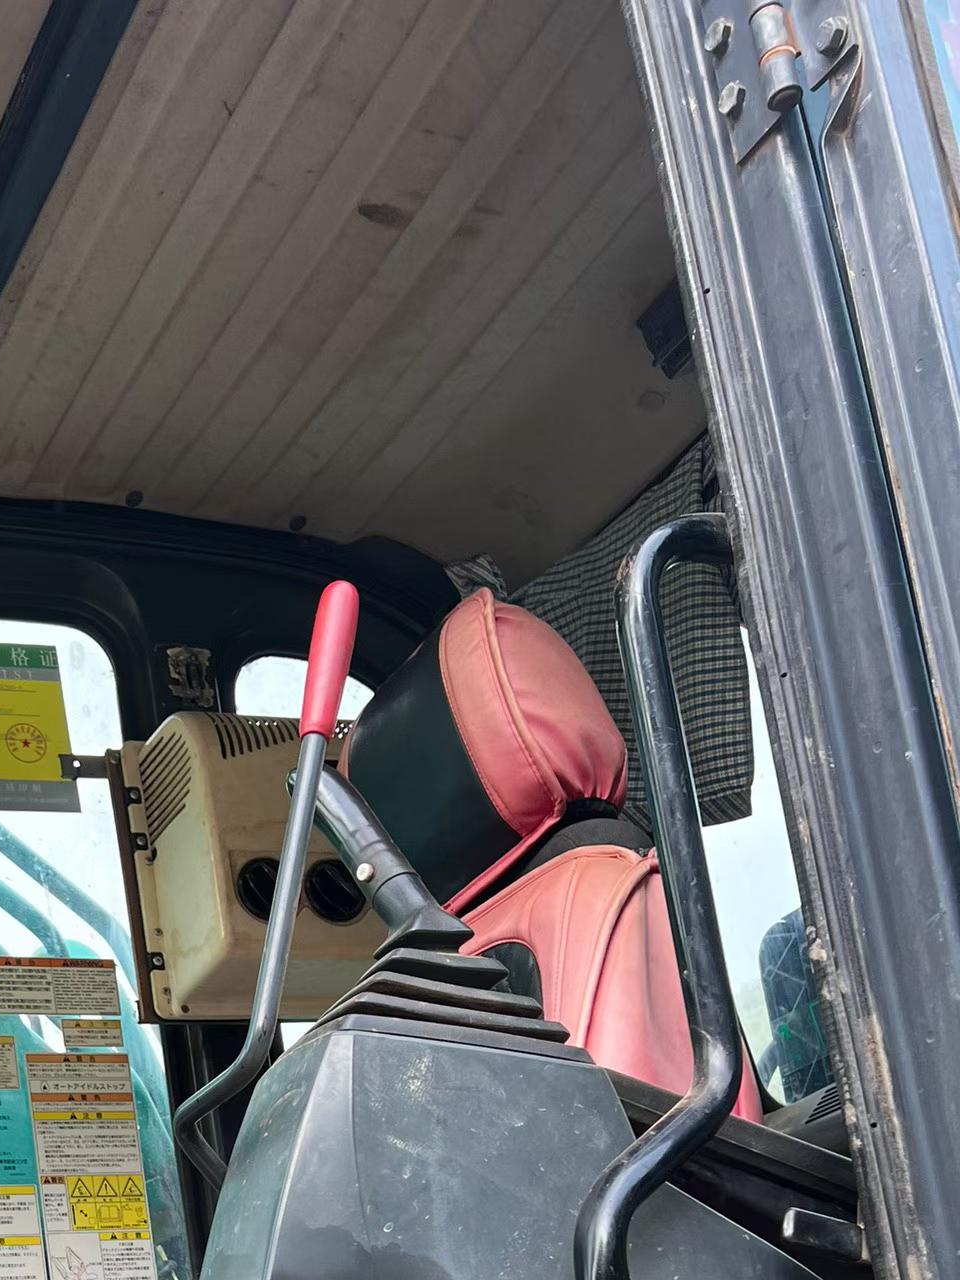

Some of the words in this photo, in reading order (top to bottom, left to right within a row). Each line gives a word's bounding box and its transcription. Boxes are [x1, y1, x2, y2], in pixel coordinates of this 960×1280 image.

[53, 1083, 126, 1091] オートアイドルストップ
